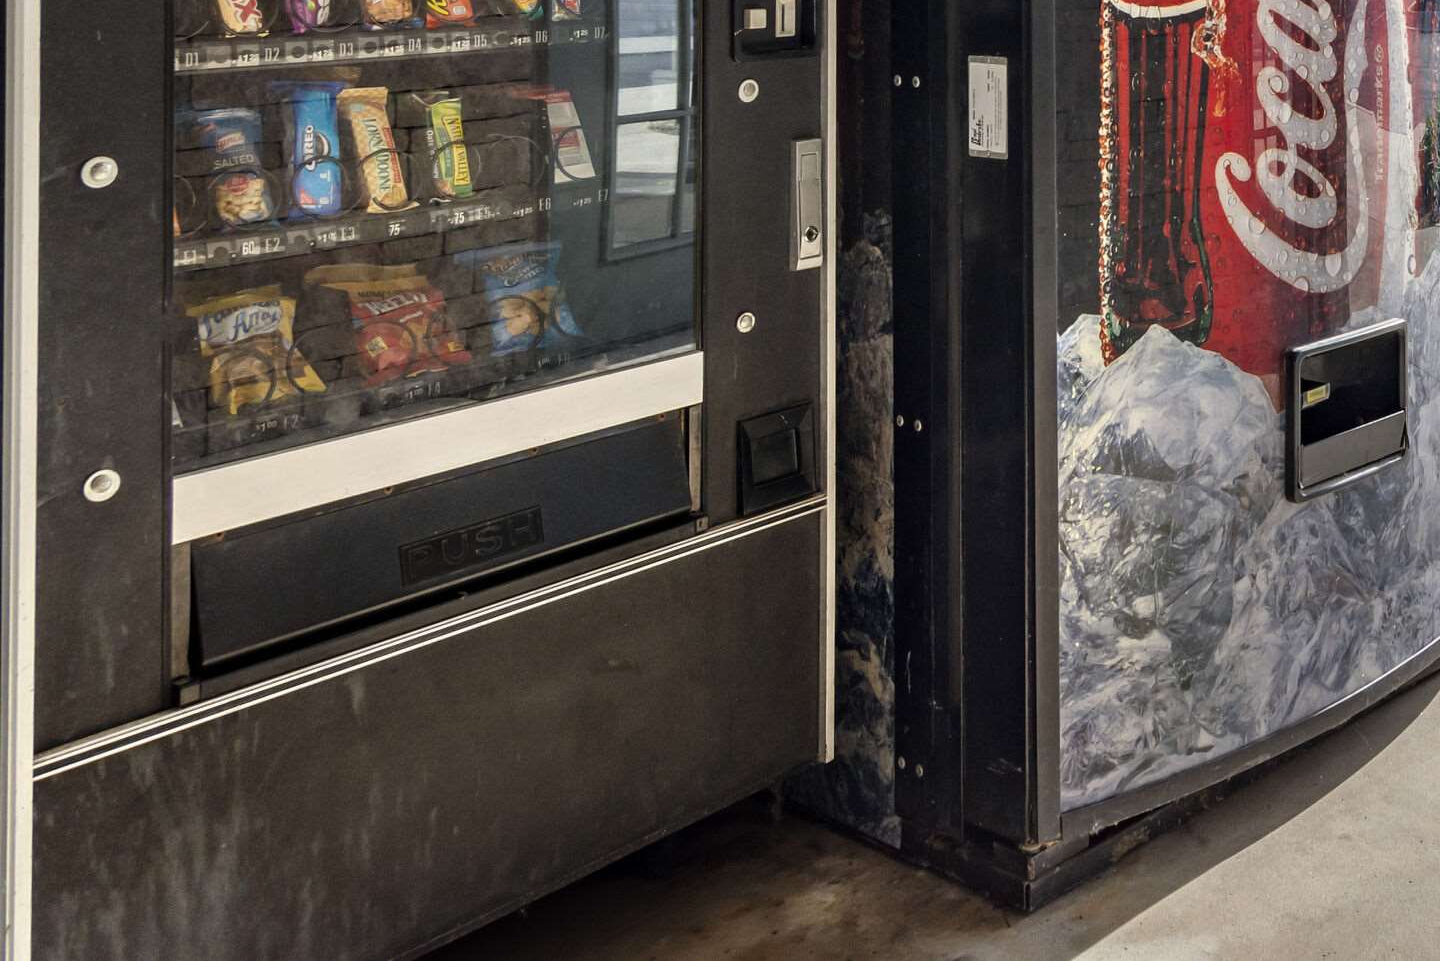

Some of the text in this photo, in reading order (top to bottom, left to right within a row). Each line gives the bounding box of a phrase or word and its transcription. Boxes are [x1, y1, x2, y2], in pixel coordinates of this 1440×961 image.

[474, 34, 487, 47] D5
[536, 30, 548, 43] D6
[339, 42, 354, 57] D3
[408, 38, 422, 52] D4
[185, 52, 199, 67] D1
[264, 46, 280, 62] D2
[303, 124, 315, 171] OREO
[213, 153, 255, 170] SALTED
[375, 151, 392, 192] DOONE
[265, 237, 280, 251] E2
[408, 509, 541, 583] PUSH
